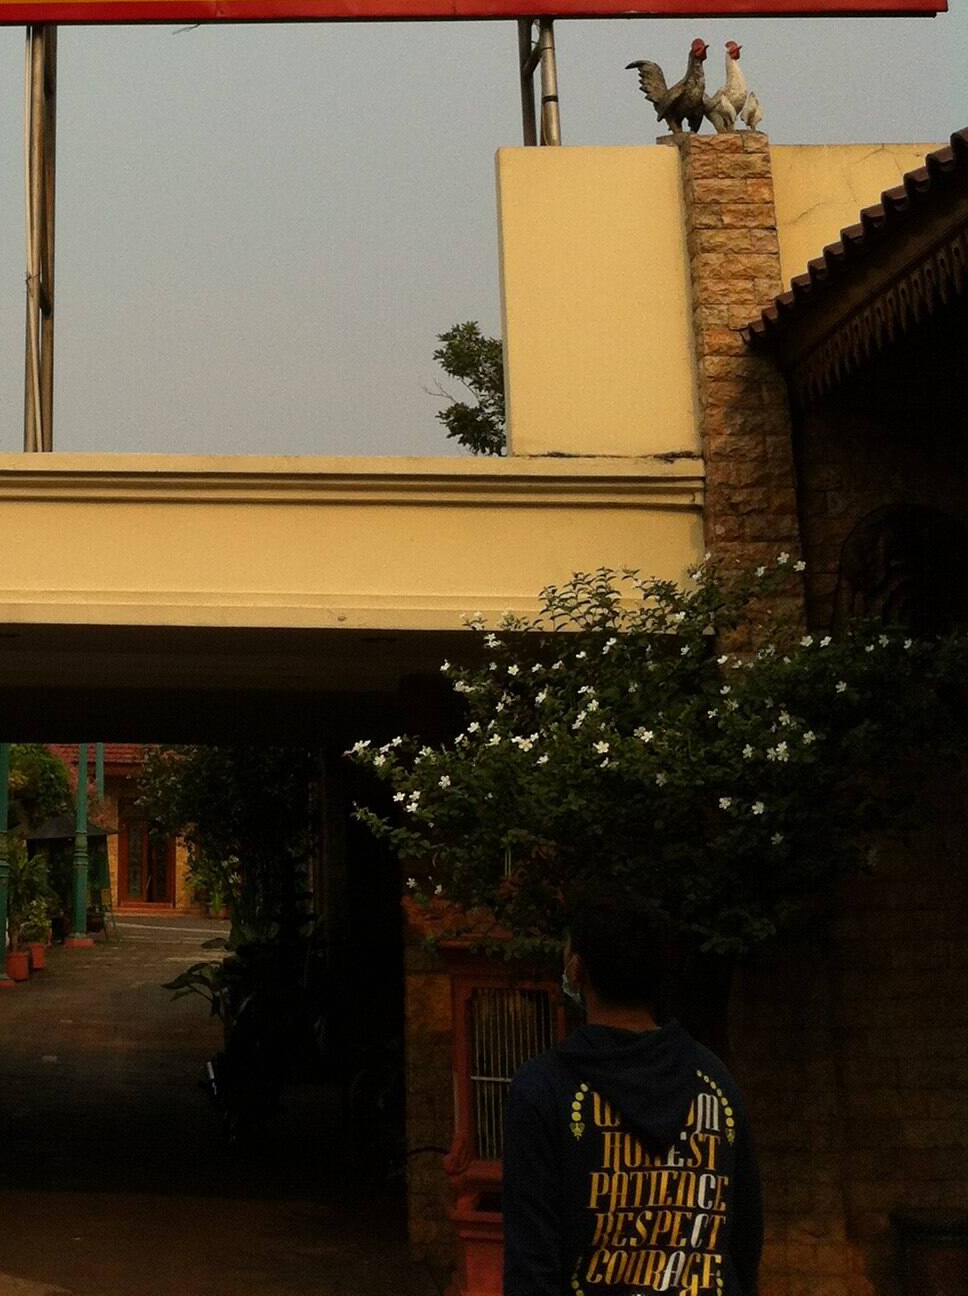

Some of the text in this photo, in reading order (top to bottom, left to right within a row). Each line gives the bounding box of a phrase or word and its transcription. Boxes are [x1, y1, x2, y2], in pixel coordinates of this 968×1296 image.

[586, 1170, 730, 1211] PATIENCE
[590, 1209, 727, 1250] RESPECT
[585, 1249, 723, 1292] COURAGE
